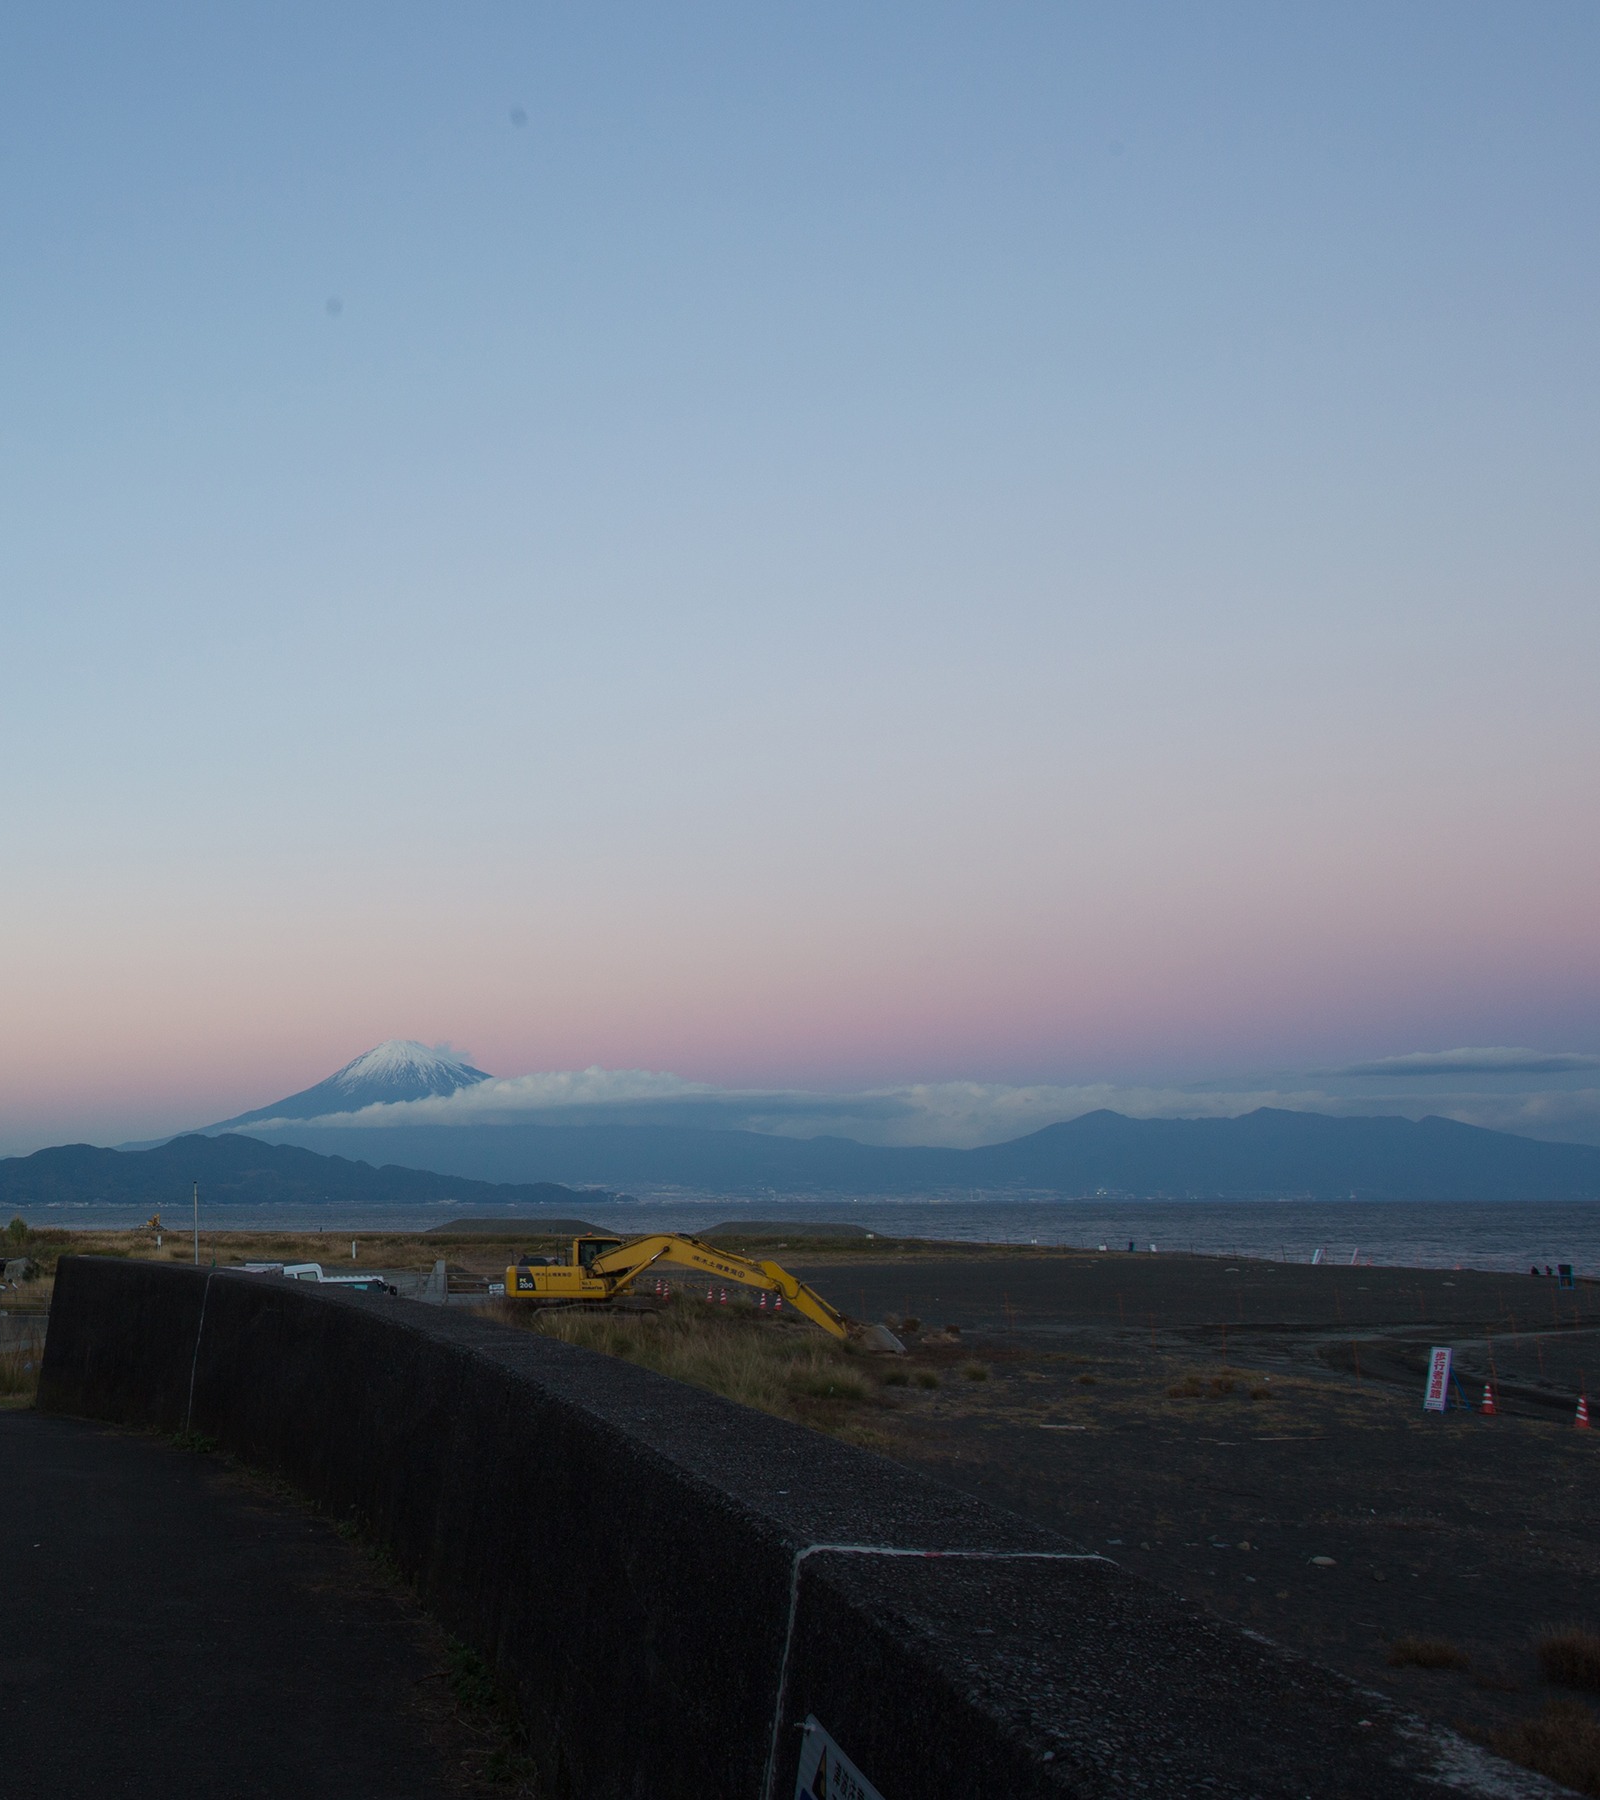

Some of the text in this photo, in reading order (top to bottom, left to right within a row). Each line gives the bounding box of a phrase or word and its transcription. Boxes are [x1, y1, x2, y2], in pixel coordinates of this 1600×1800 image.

[1430, 1352, 1446, 1399] 歩行者通路
